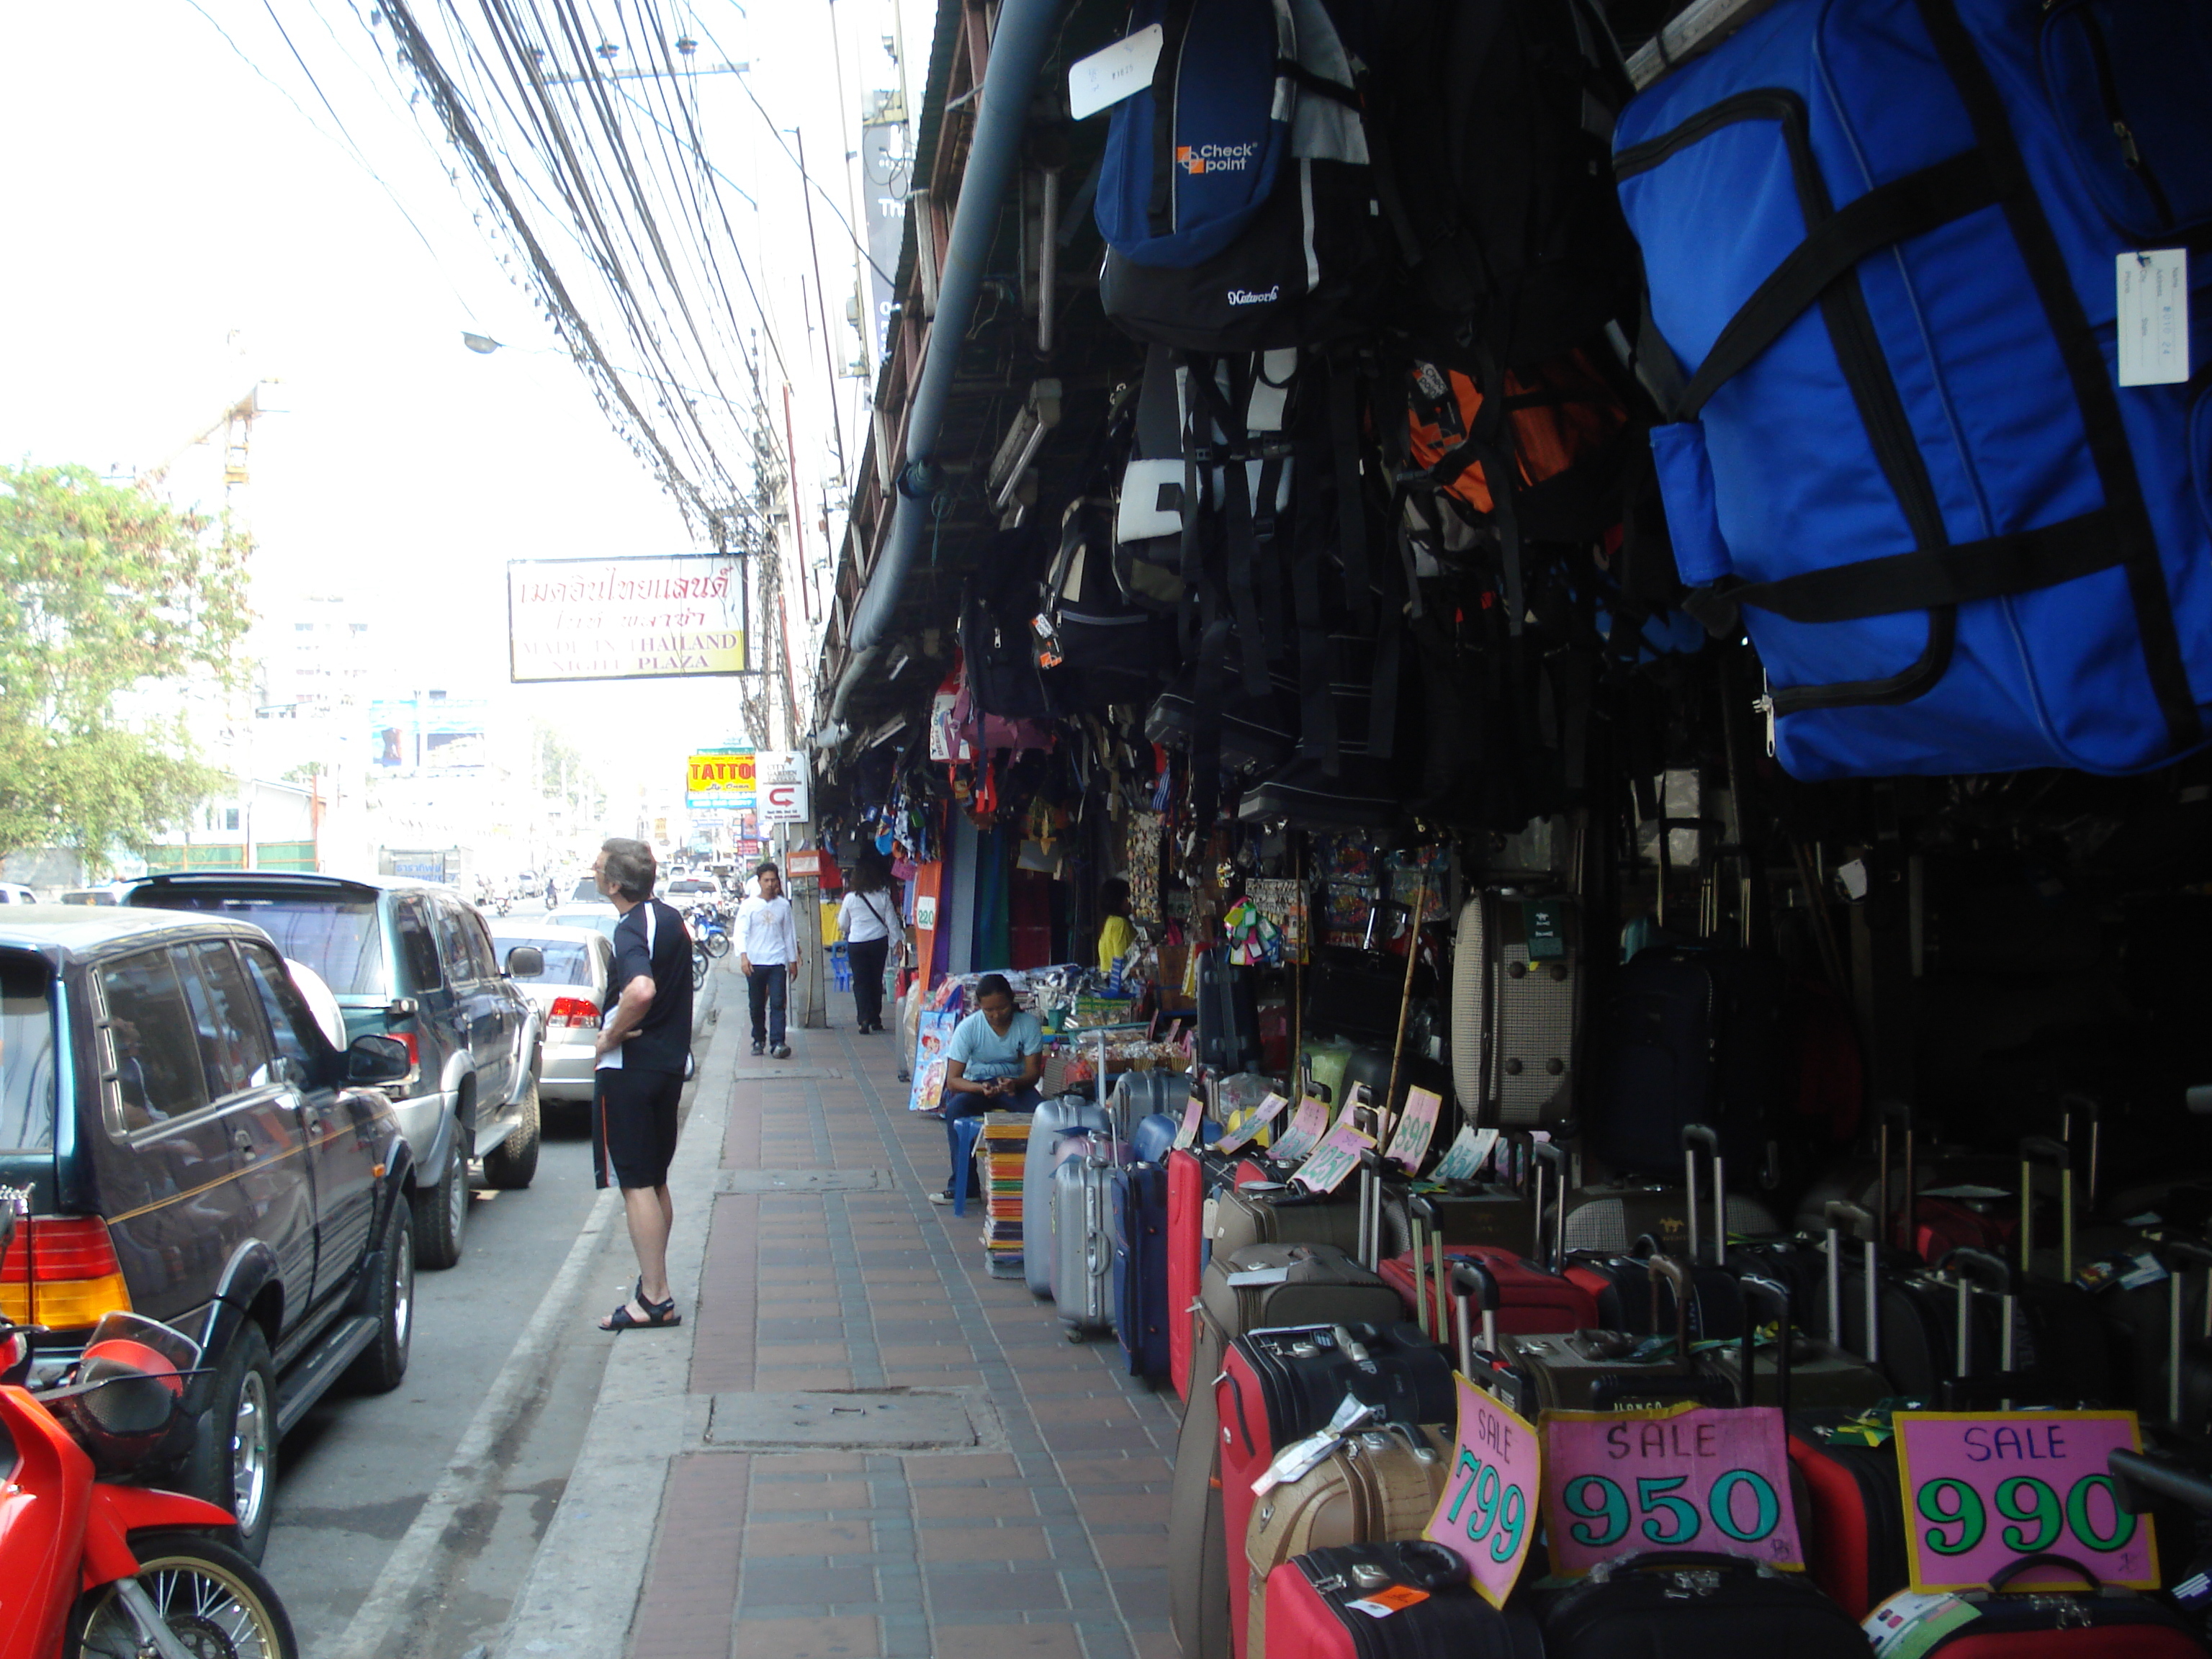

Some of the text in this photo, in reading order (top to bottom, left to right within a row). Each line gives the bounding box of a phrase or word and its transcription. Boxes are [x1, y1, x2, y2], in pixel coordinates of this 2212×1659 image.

[1201, 143, 1252, 158] Check
[1206, 156, 1247, 174] point
[627, 634, 737, 653] THAILAND
[637, 654, 710, 670] PLAZA
[918, 909, 935, 925] 220
[1395, 1115, 1431, 1159] 890
[1299, 1143, 1355, 1188] 1250
[1478, 1408, 1513, 1465] SALE
[1607, 1421, 1717, 1460] SALE
[1964, 1425, 2068, 1462] SALE
[1447, 1444, 1526, 1564] 799
[1563, 1468, 1780, 1547] 950
[1917, 1473, 2138, 1556] 990
